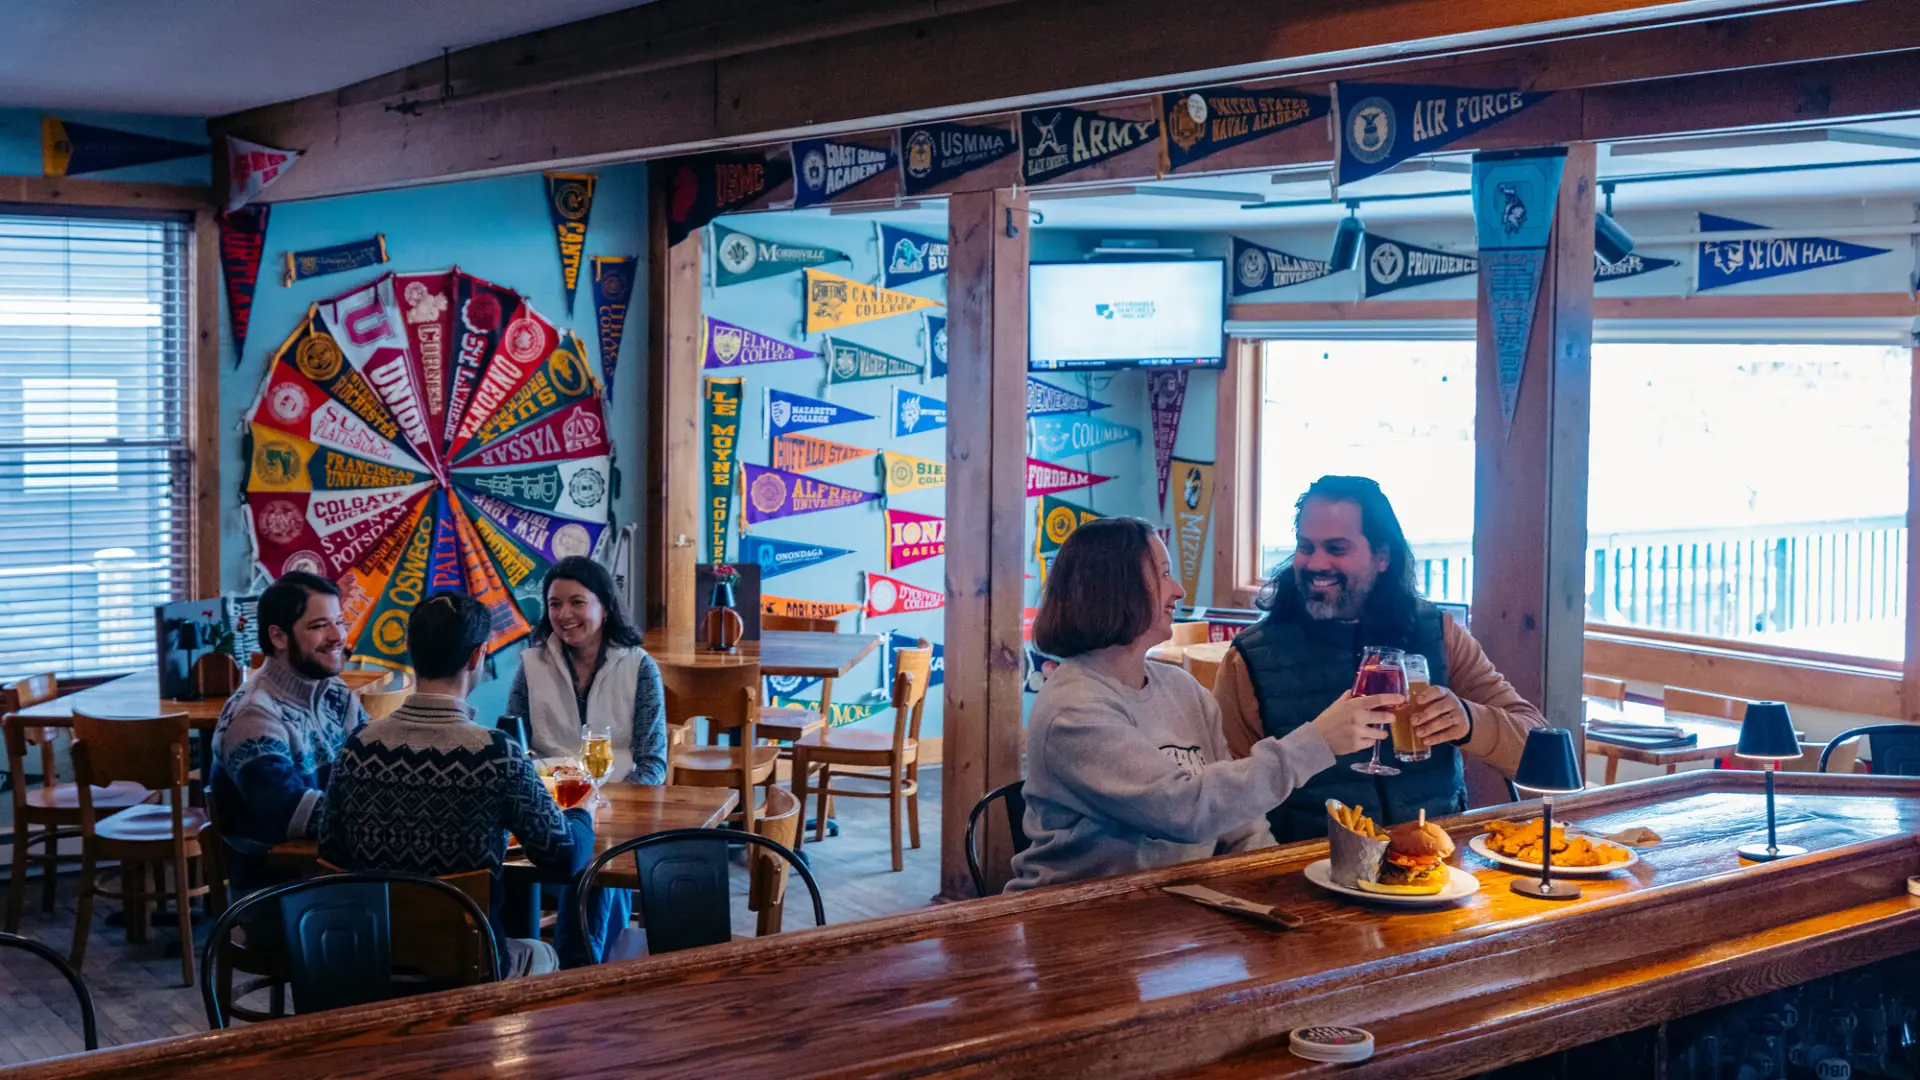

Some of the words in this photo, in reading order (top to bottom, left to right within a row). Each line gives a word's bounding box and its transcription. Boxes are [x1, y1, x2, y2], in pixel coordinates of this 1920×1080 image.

[1208, 97, 1254, 116] UNITED
[1259, 97, 1309, 113] STATES
[1413, 100, 1450, 143] AIR
[1455, 92, 1524, 127] FORCE
[1073, 116, 1154, 163] ARMY
[1211, 117, 1249, 142] NAVAL
[1252, 108, 1311, 131] ACADEMY
[825, 144, 856, 167] COAST
[858, 149, 886, 164] GUARD
[941, 131, 1004, 156] USMMA
[716, 164, 765, 207] USMC
[826, 162, 886, 194] ACADEMY
[563, 222, 585, 289] CANTON
[1268, 252, 1333, 275] VILLANOVA
[1408, 251, 1478, 276] PROVIDENCE
[1802, 243, 1843, 263] HALL
[1273, 270, 1330, 287] UNIVERSITY
[1490, 260, 1536, 302] THE
[856, 303, 913, 317] COLLEGE
[741, 347, 794, 363] COLLEGE
[742, 331, 794, 354] ELMIRA
[1495, 307, 1528, 390] CITADEL
[417, 324, 443, 415] CORNELL
[329, 375, 399, 440] ROCHESTER
[370, 355, 429, 446] UNION
[458, 354, 523, 439] ONEONTA
[478, 371, 548, 438] BROCKPORT
[712, 391, 738, 416] LE
[792, 406, 836, 416] NAZARETH
[477, 386, 557, 446] SUNY
[792, 414, 830, 423] COLLEGE
[480, 424, 561, 465] VASSAR
[1072, 422, 1129, 449] COLUMBIA
[325, 451, 415, 480] FRANCISCAN
[711, 424, 736, 485] MOYNE
[829, 445, 862, 462] STATE
[326, 469, 413, 487] UNIVERSITY
[792, 479, 864, 502] ALFRED
[1027, 464, 1089, 489] FORDHAM
[314, 490, 405, 519] COLGATE
[473, 495, 510, 526] YORK
[793, 493, 862, 511] UNIVERSITY
[331, 505, 408, 573] POTSDAM
[513, 521, 550, 551] NEW
[713, 497, 727, 564] COLLE
[389, 516, 433, 605] OSWEGO
[433, 515, 461, 587] PALTZ
[475, 516, 530, 588] HERKIMER
[775, 549, 824, 561] ONONDAGA
[902, 544, 945, 557] GAELS
[904, 599, 940, 610] COLLEGE
